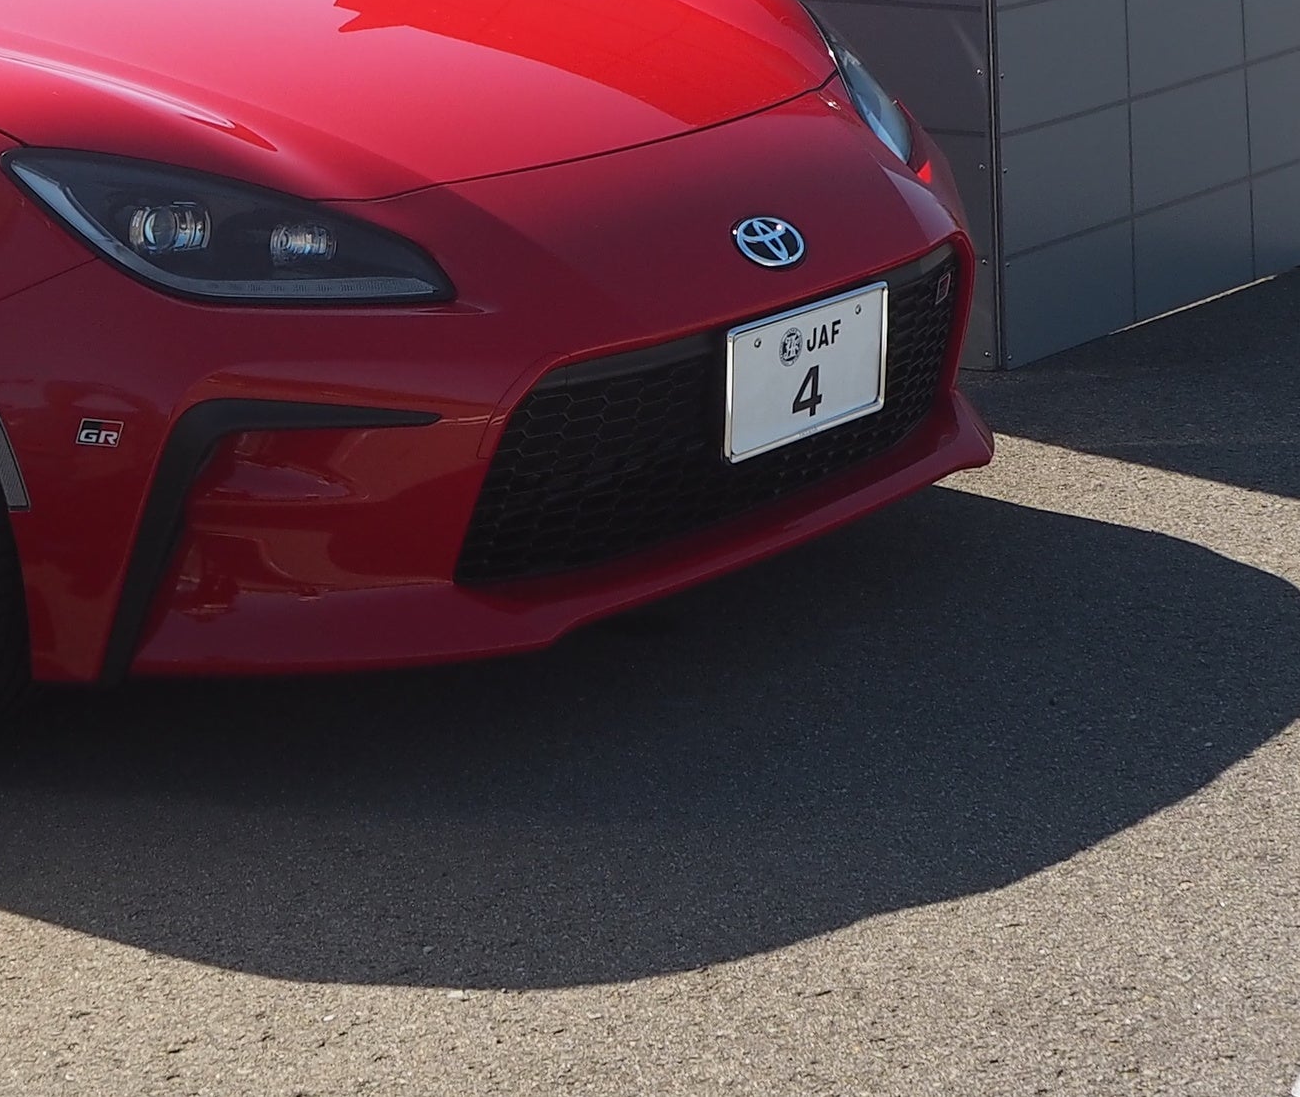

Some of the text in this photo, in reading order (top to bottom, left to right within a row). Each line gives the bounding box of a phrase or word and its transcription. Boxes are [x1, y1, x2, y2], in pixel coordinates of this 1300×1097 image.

[806, 319, 841, 352] JAF
[792, 365, 822, 417] 4
[79, 429, 118, 445] GR
